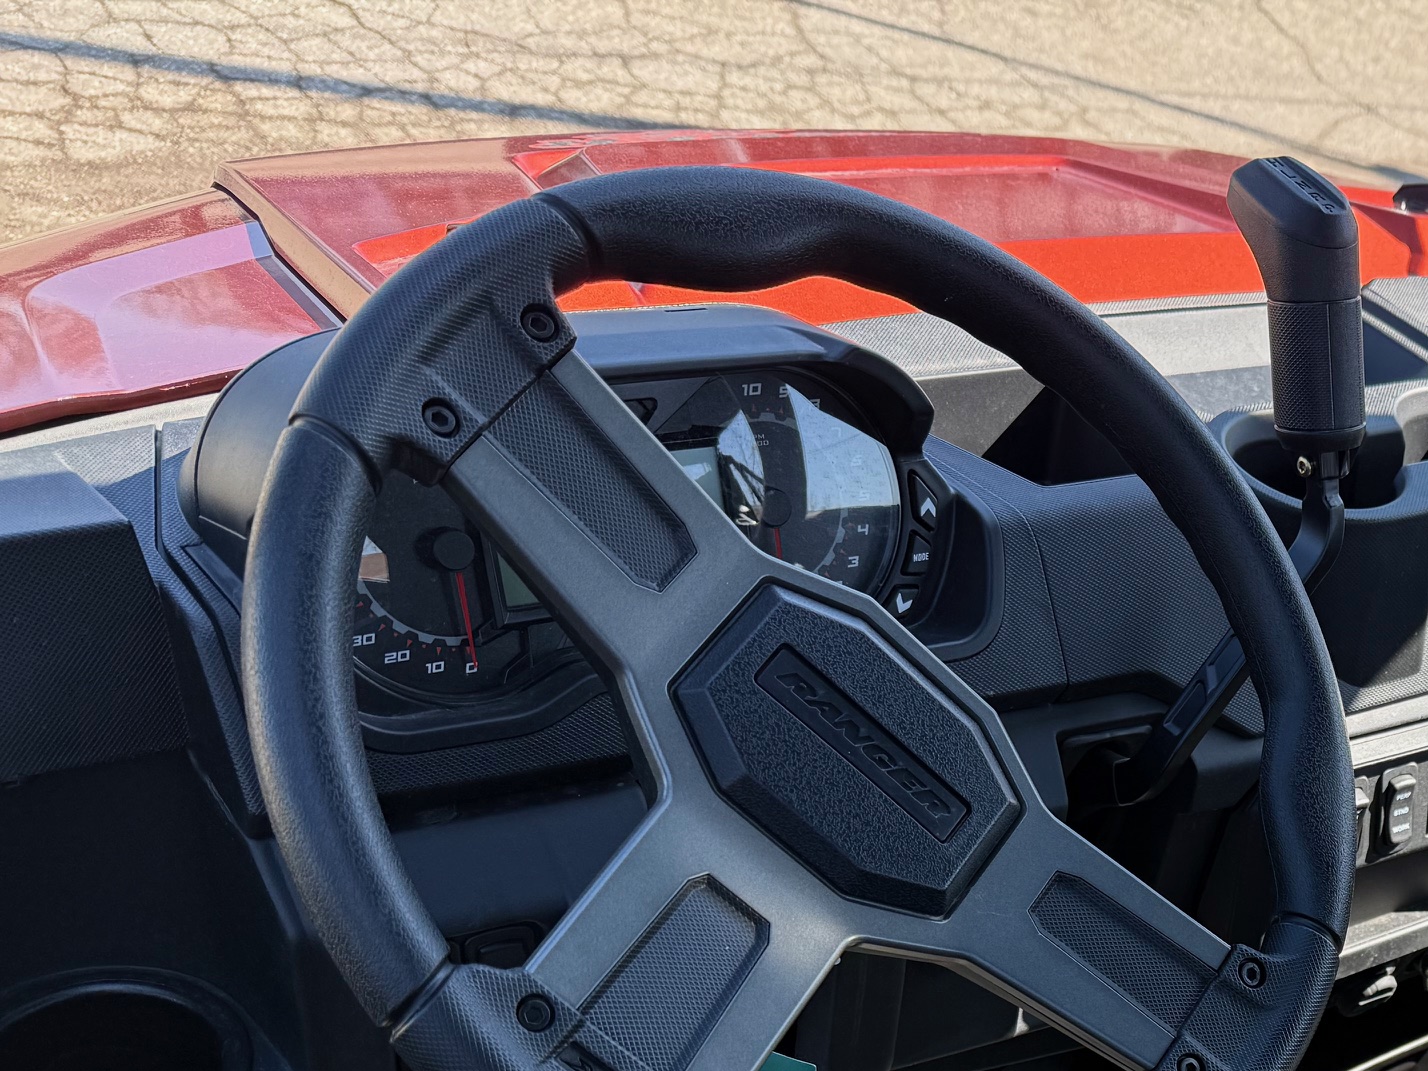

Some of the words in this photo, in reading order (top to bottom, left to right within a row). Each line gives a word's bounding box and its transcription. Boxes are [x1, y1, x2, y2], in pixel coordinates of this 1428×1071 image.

[742, 383, 761, 396] 10
[857, 523, 869, 536] 4
[847, 555, 859, 568] 3
[352, 633, 376, 647] 30
[384, 650, 410, 664] 20
[425, 661, 445, 674] 10
[465, 661, 478, 674] 0
[774, 672, 951, 819] RANGER
